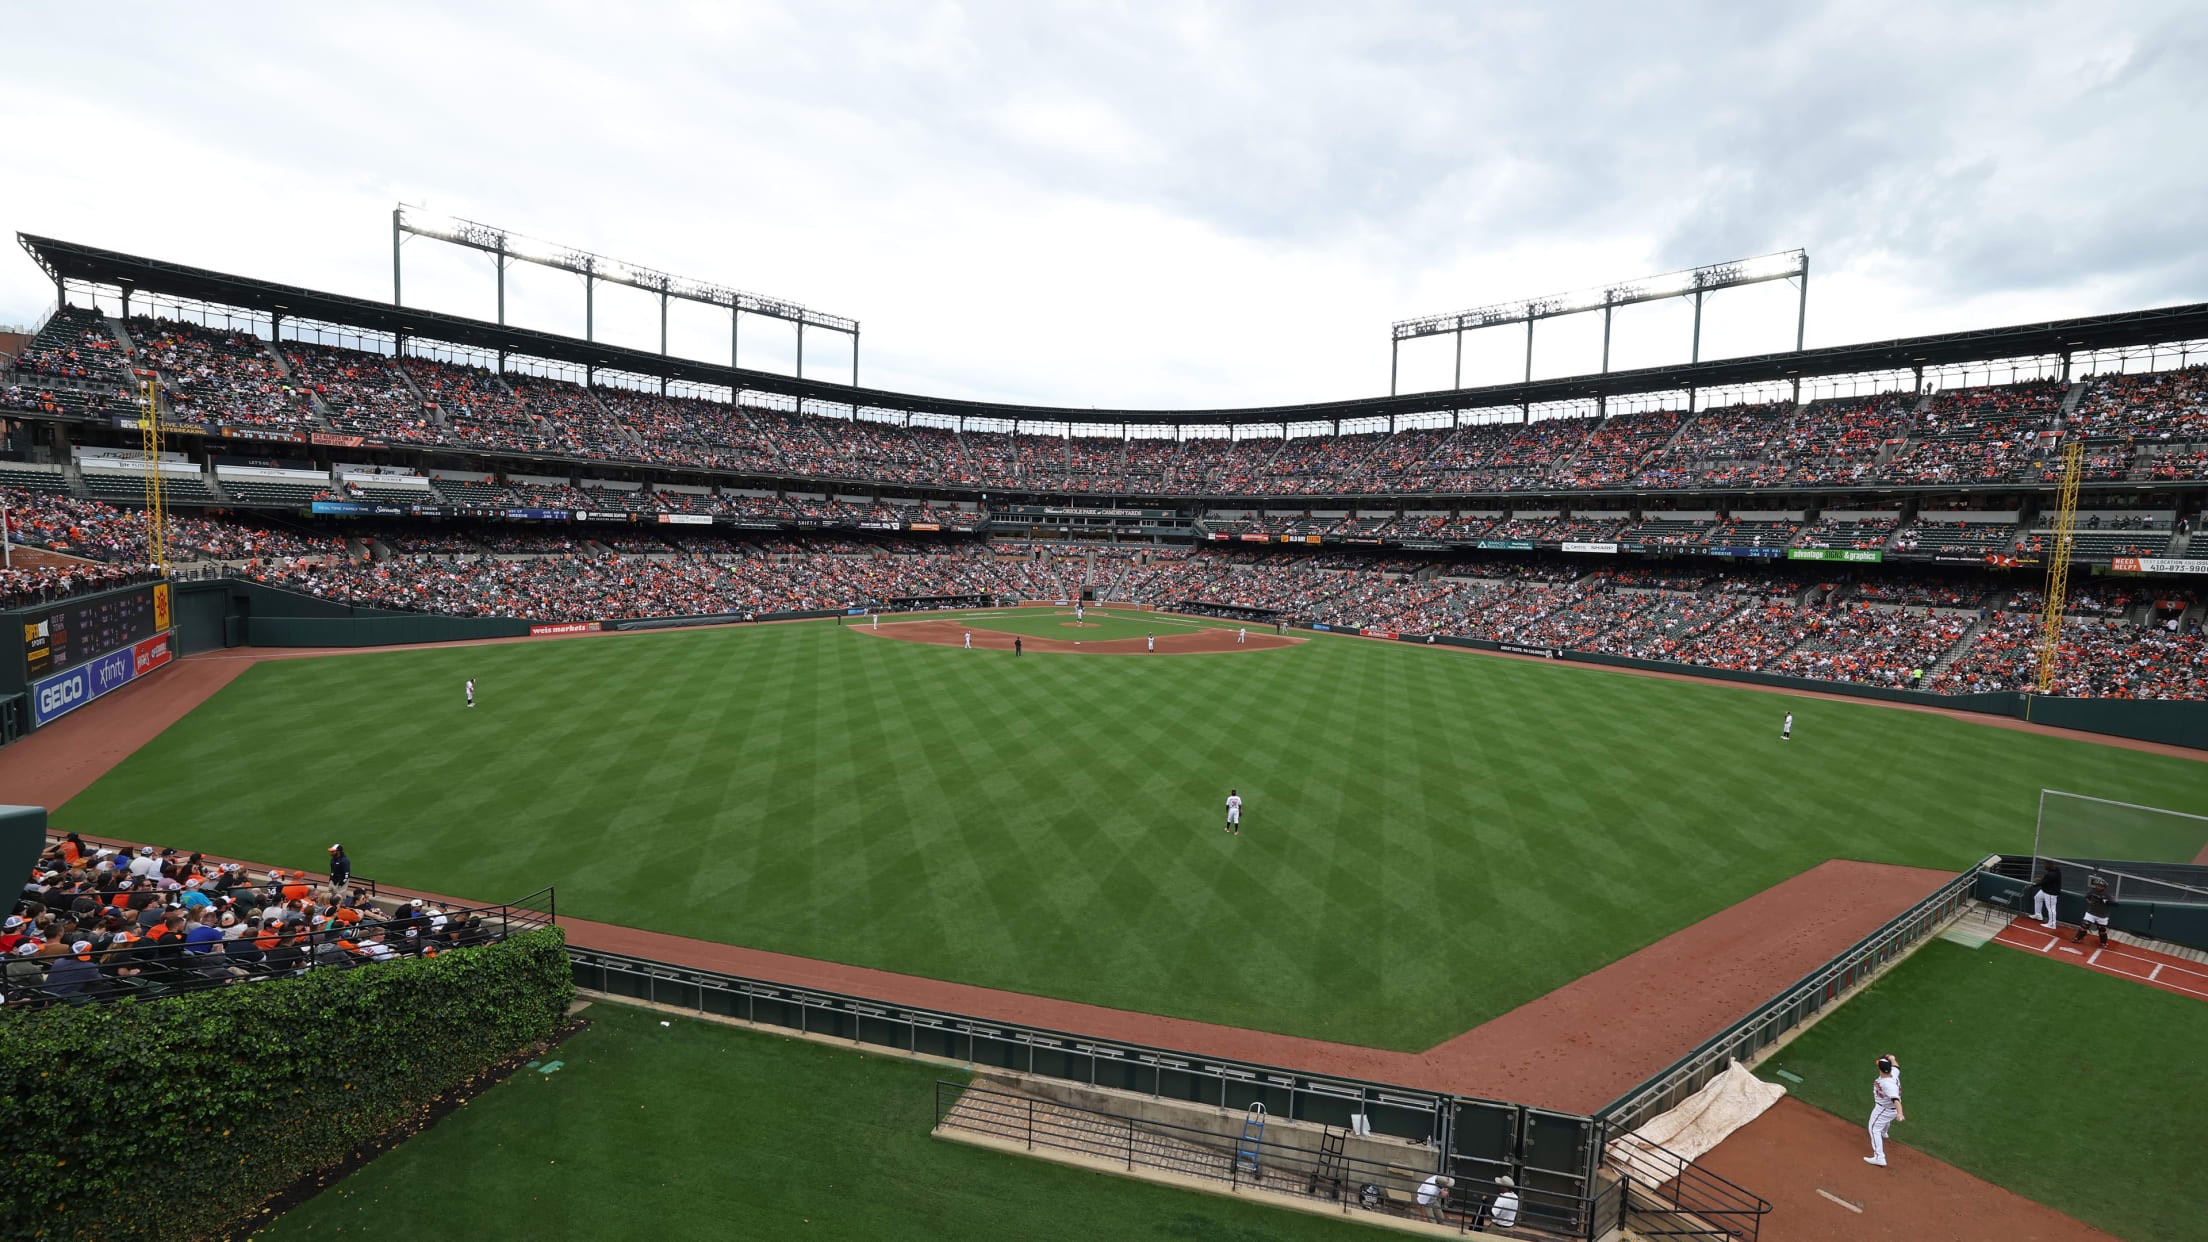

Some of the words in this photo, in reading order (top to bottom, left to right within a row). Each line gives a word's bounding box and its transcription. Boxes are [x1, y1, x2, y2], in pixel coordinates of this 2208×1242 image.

[1794, 550, 1823, 559] advantage
[32, 638, 46, 647] SPORTS
[100, 656, 126, 688] xfinity
[41, 676, 82, 713] GEICO
